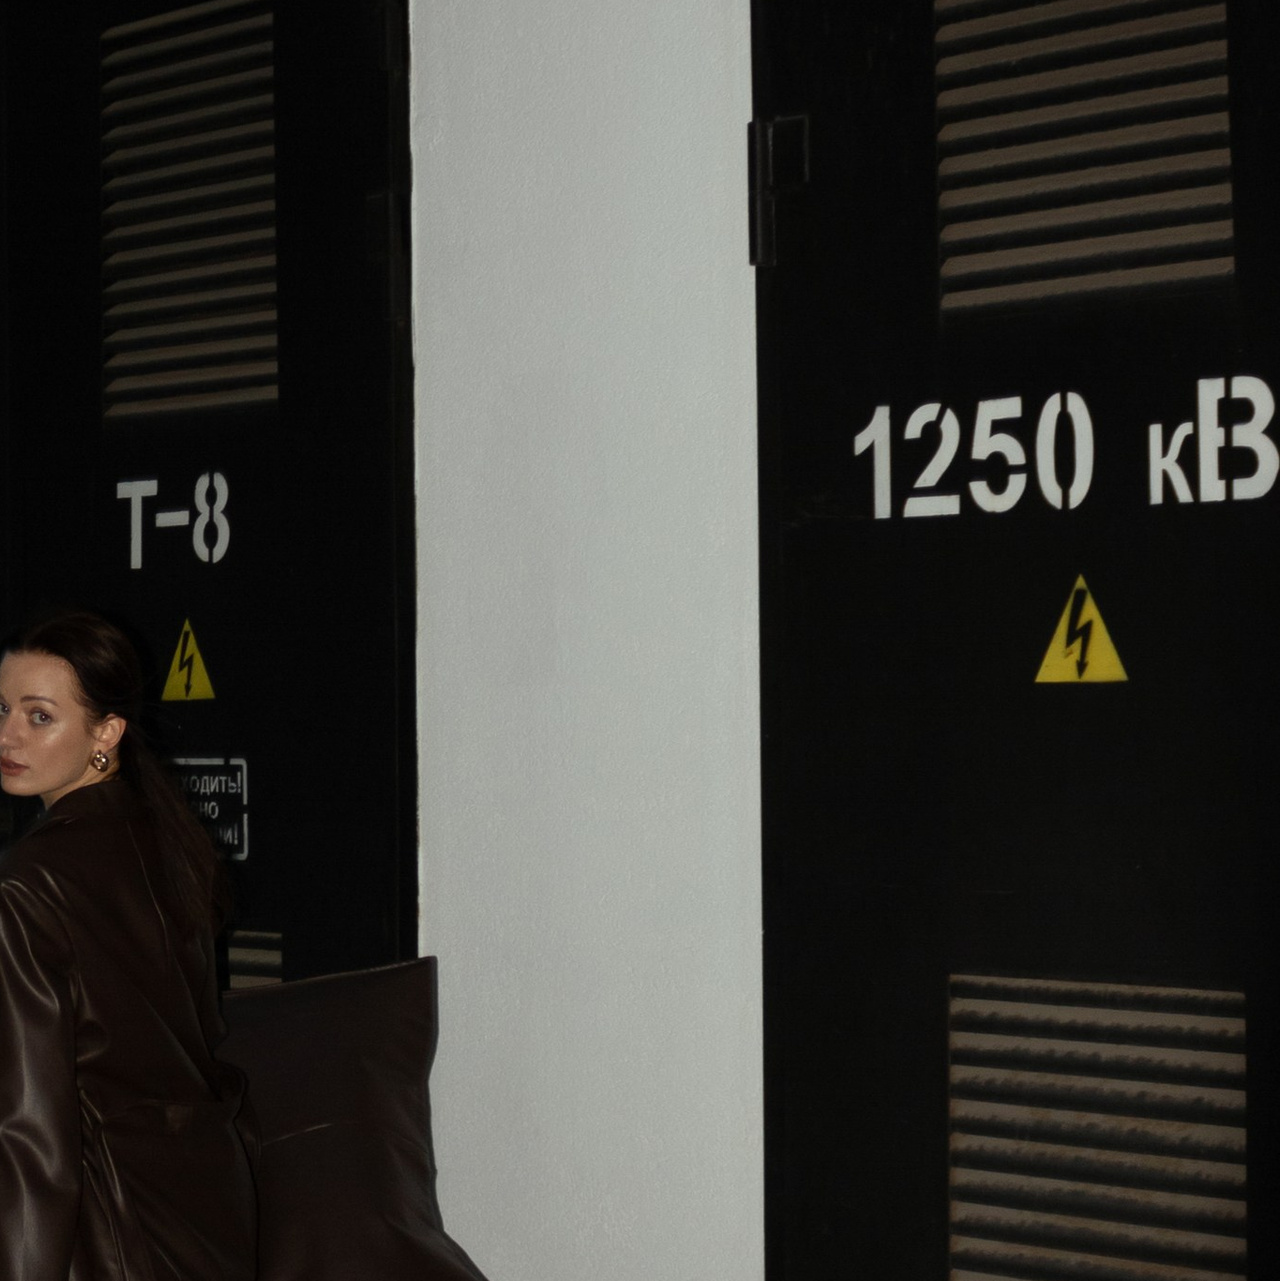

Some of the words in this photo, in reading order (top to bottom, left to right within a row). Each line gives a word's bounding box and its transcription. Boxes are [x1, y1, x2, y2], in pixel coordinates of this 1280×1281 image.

[853, 390, 1095, 520] 1250
[116, 471, 231, 570] Т-8
[180, 771, 242, 796] ХОДИТЬ!
